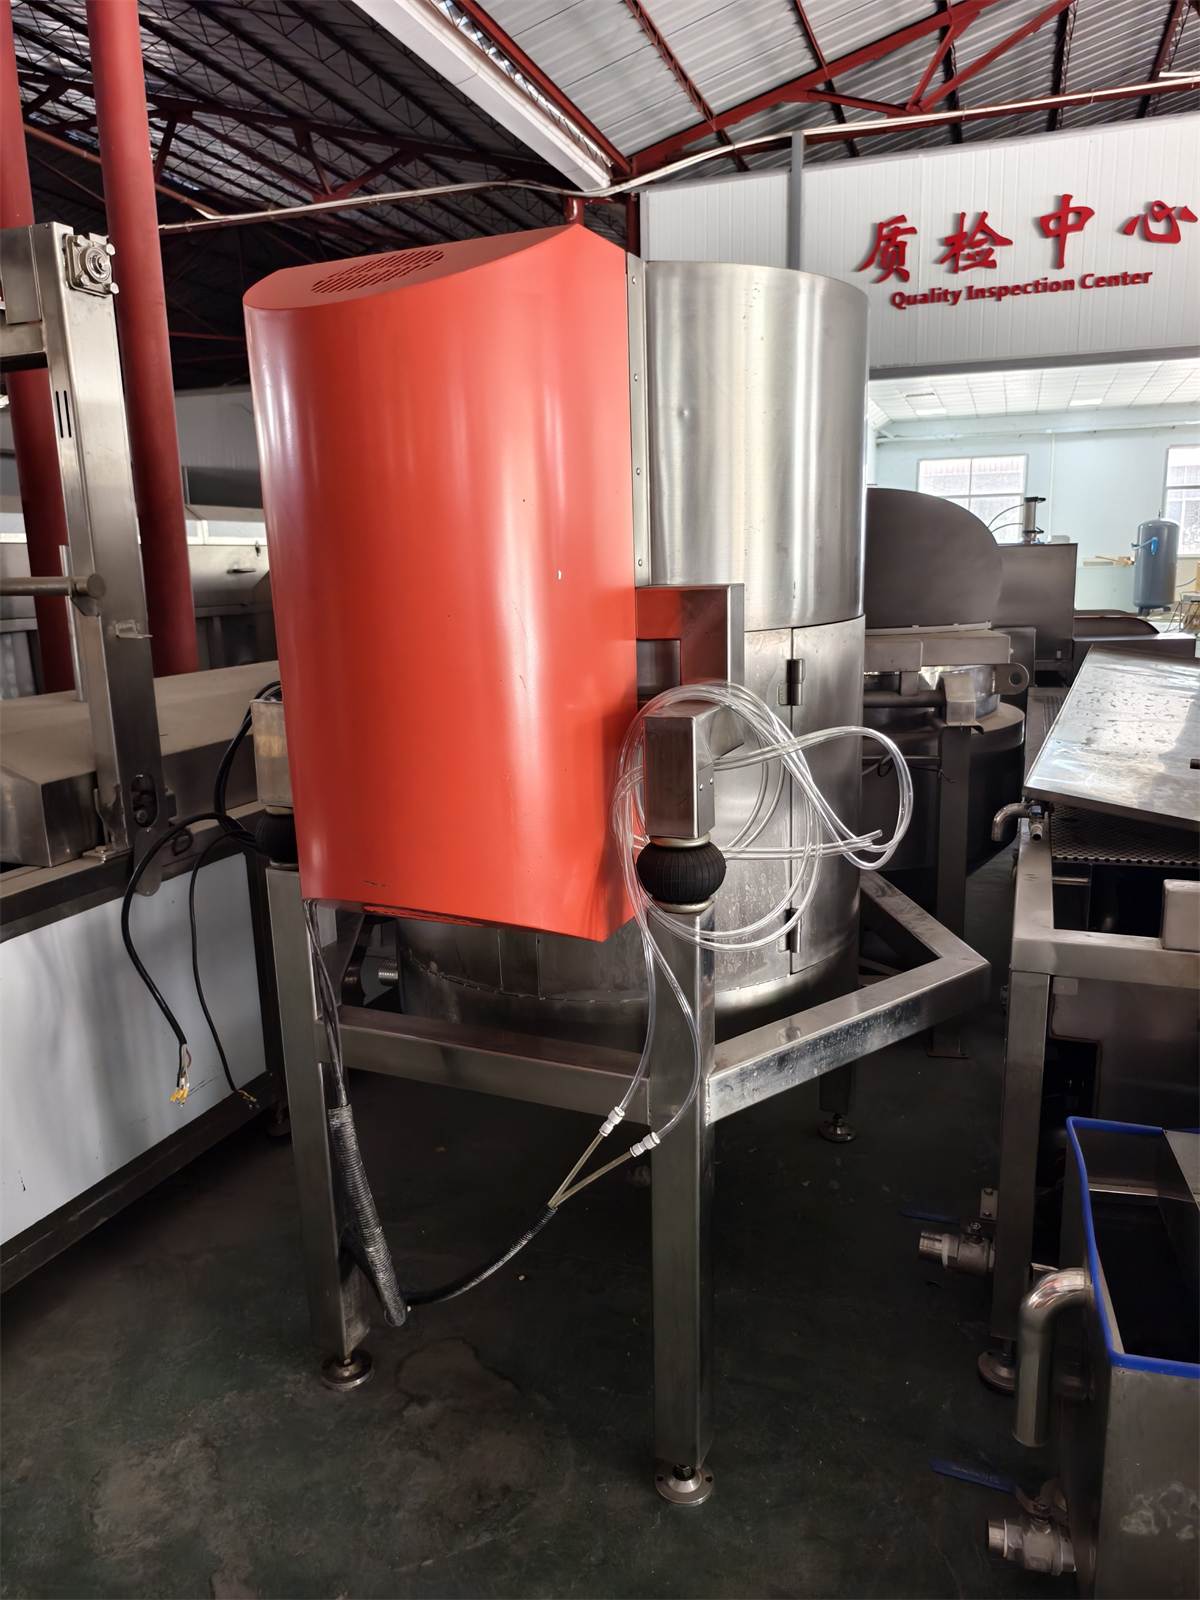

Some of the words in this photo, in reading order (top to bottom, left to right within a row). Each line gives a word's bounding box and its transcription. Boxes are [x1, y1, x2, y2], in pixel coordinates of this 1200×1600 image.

[858, 194, 1198, 283] 质检中心
[891, 288, 962, 309] Quality
[966, 278, 1075, 301] Inspection
[1079, 271, 1153, 290] Center
